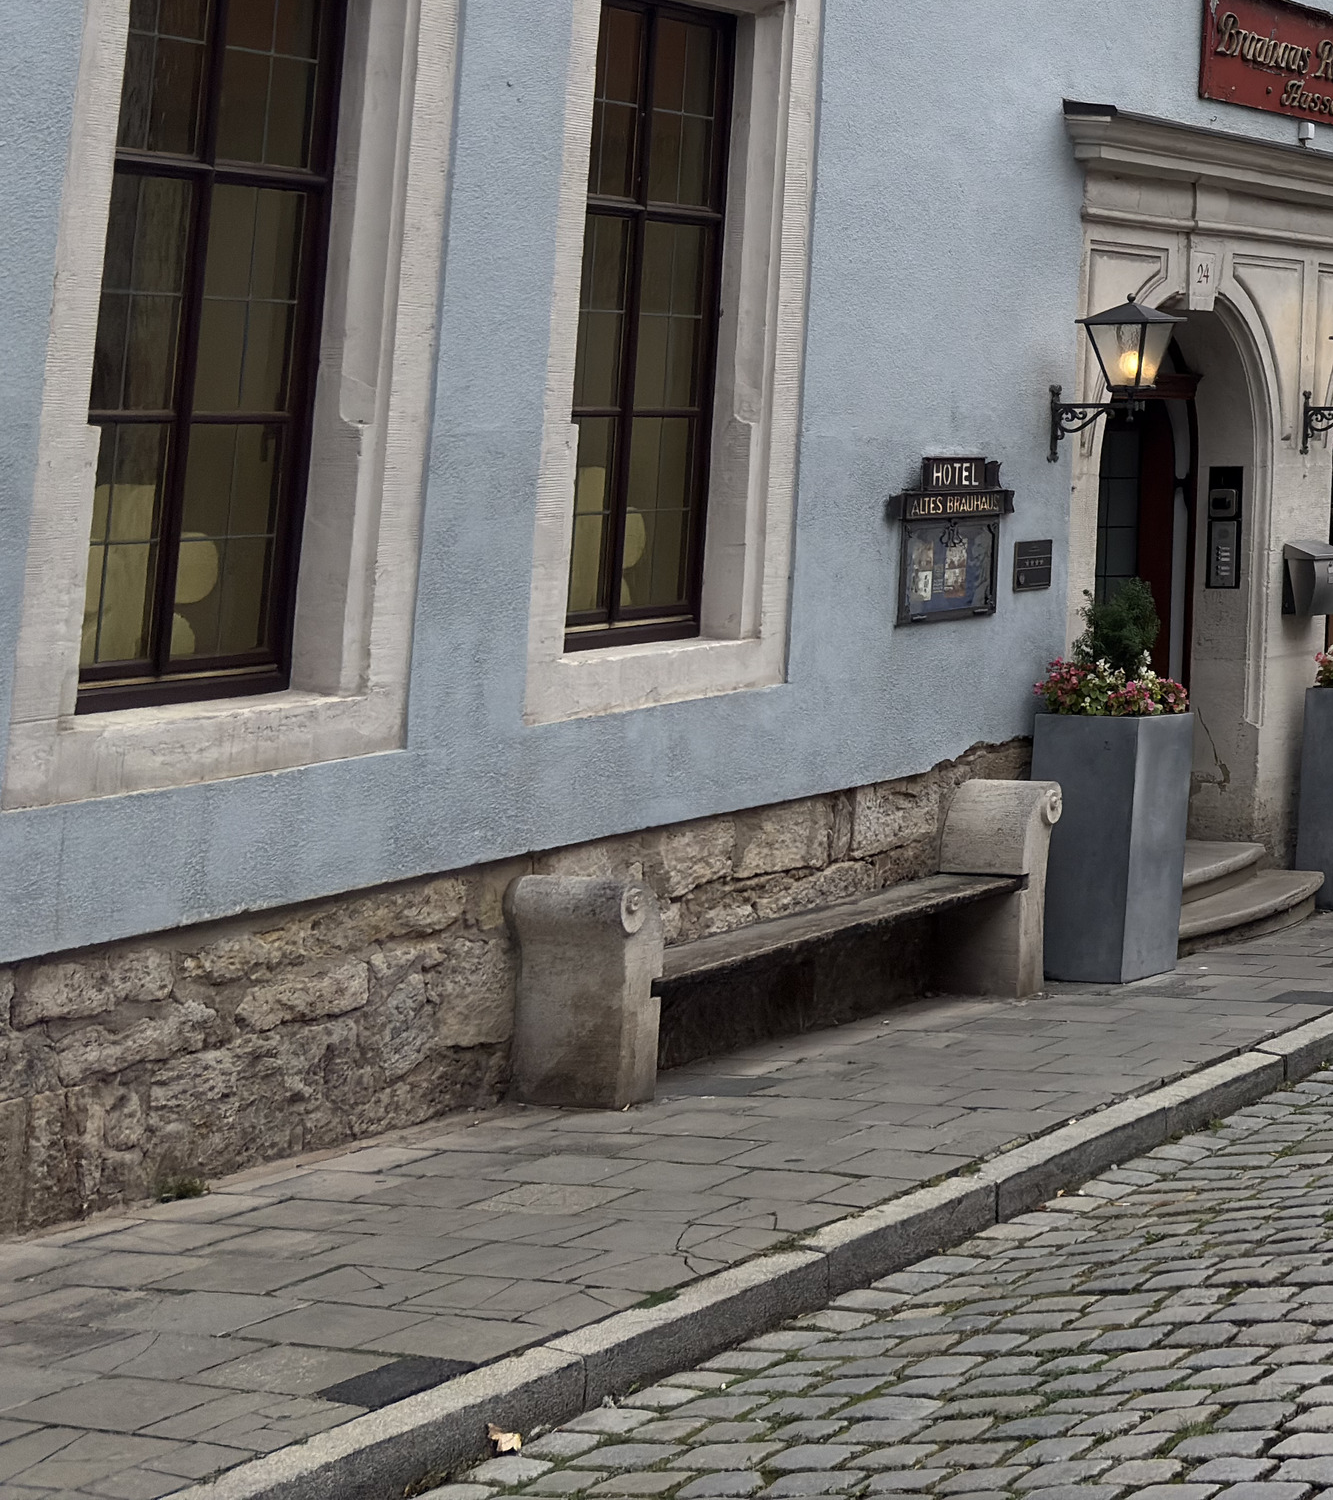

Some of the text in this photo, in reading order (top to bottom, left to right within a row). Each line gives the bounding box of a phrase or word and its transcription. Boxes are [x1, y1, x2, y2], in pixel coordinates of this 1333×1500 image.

[1196, 263, 1210, 285] 24
[932, 463, 979, 486] HOTEL
[911, 494, 1000, 516] ALTES BRAUHAUS
